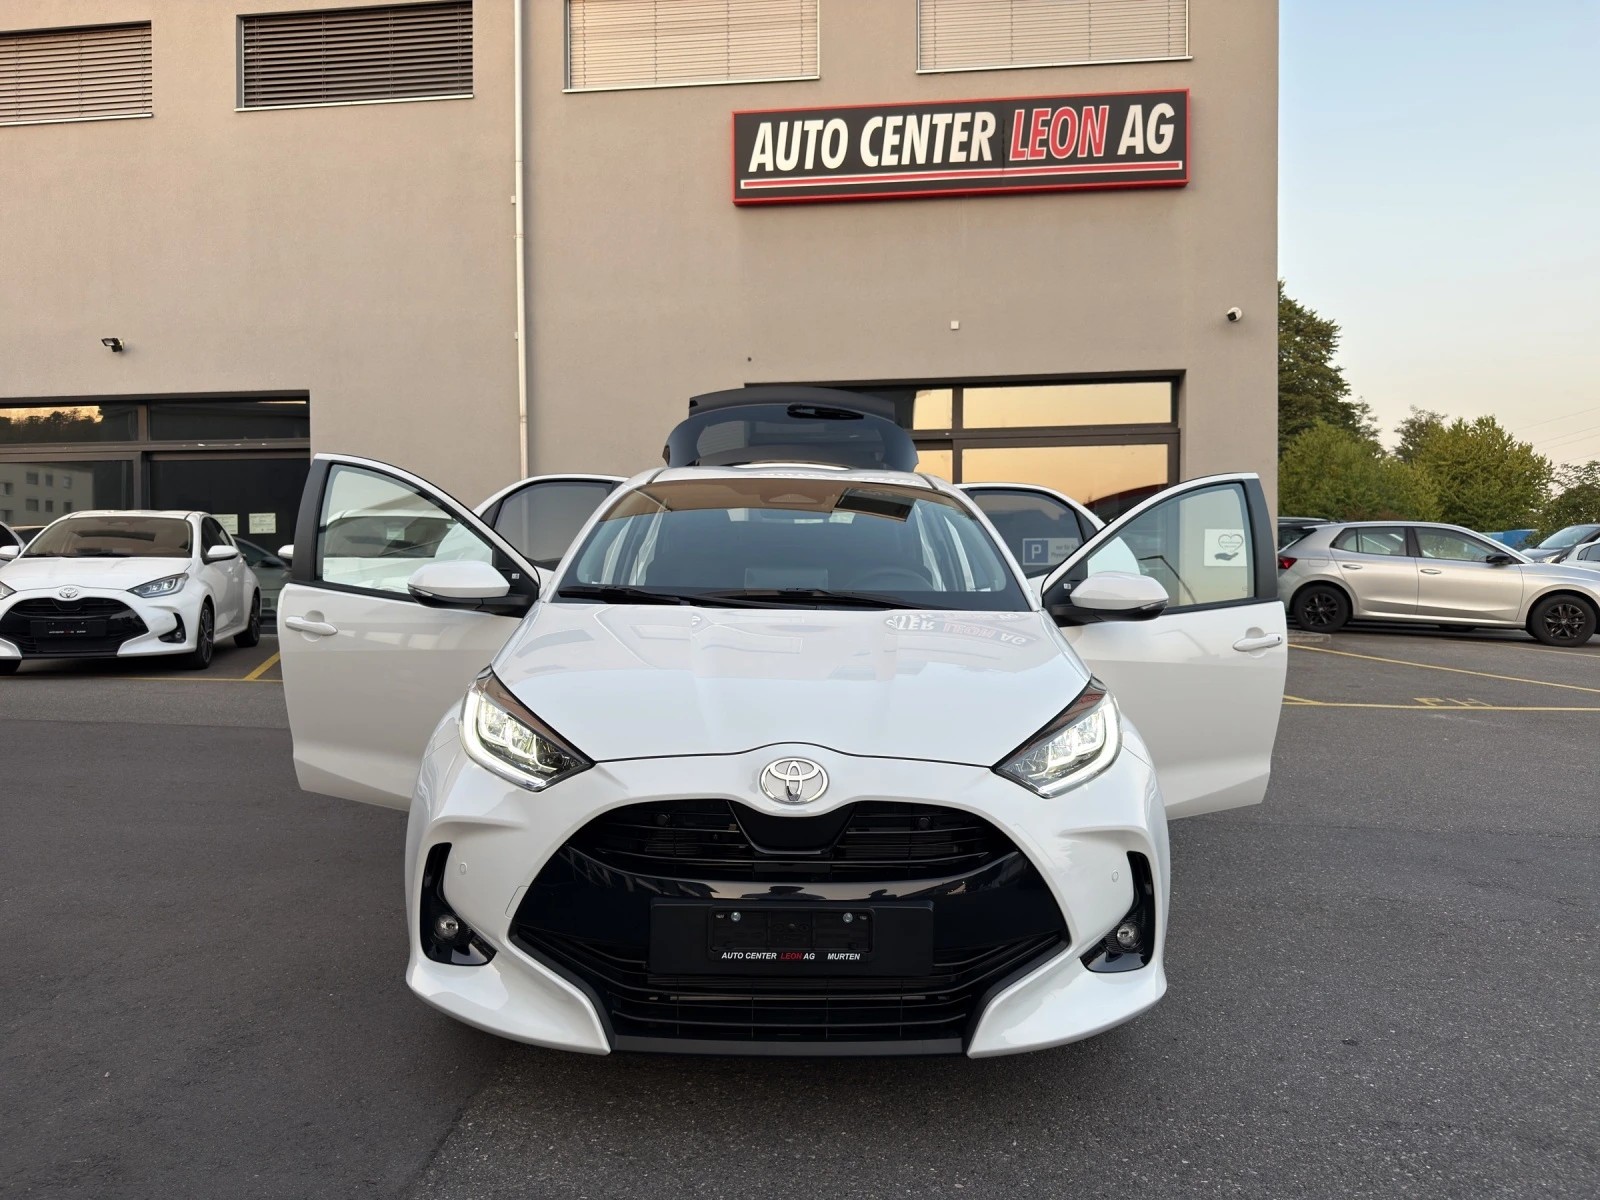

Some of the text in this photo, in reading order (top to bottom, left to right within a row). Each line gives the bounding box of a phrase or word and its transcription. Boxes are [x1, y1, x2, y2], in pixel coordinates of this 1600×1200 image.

[748, 102, 1176, 172] AUTO CENTER LEON AG
[1031, 544, 1042, 560] P
[721, 952, 744, 960] AUTO
[745, 952, 777, 960] CENTER
[780, 952, 802, 960] LEON
[803, 952, 816, 960] AG
